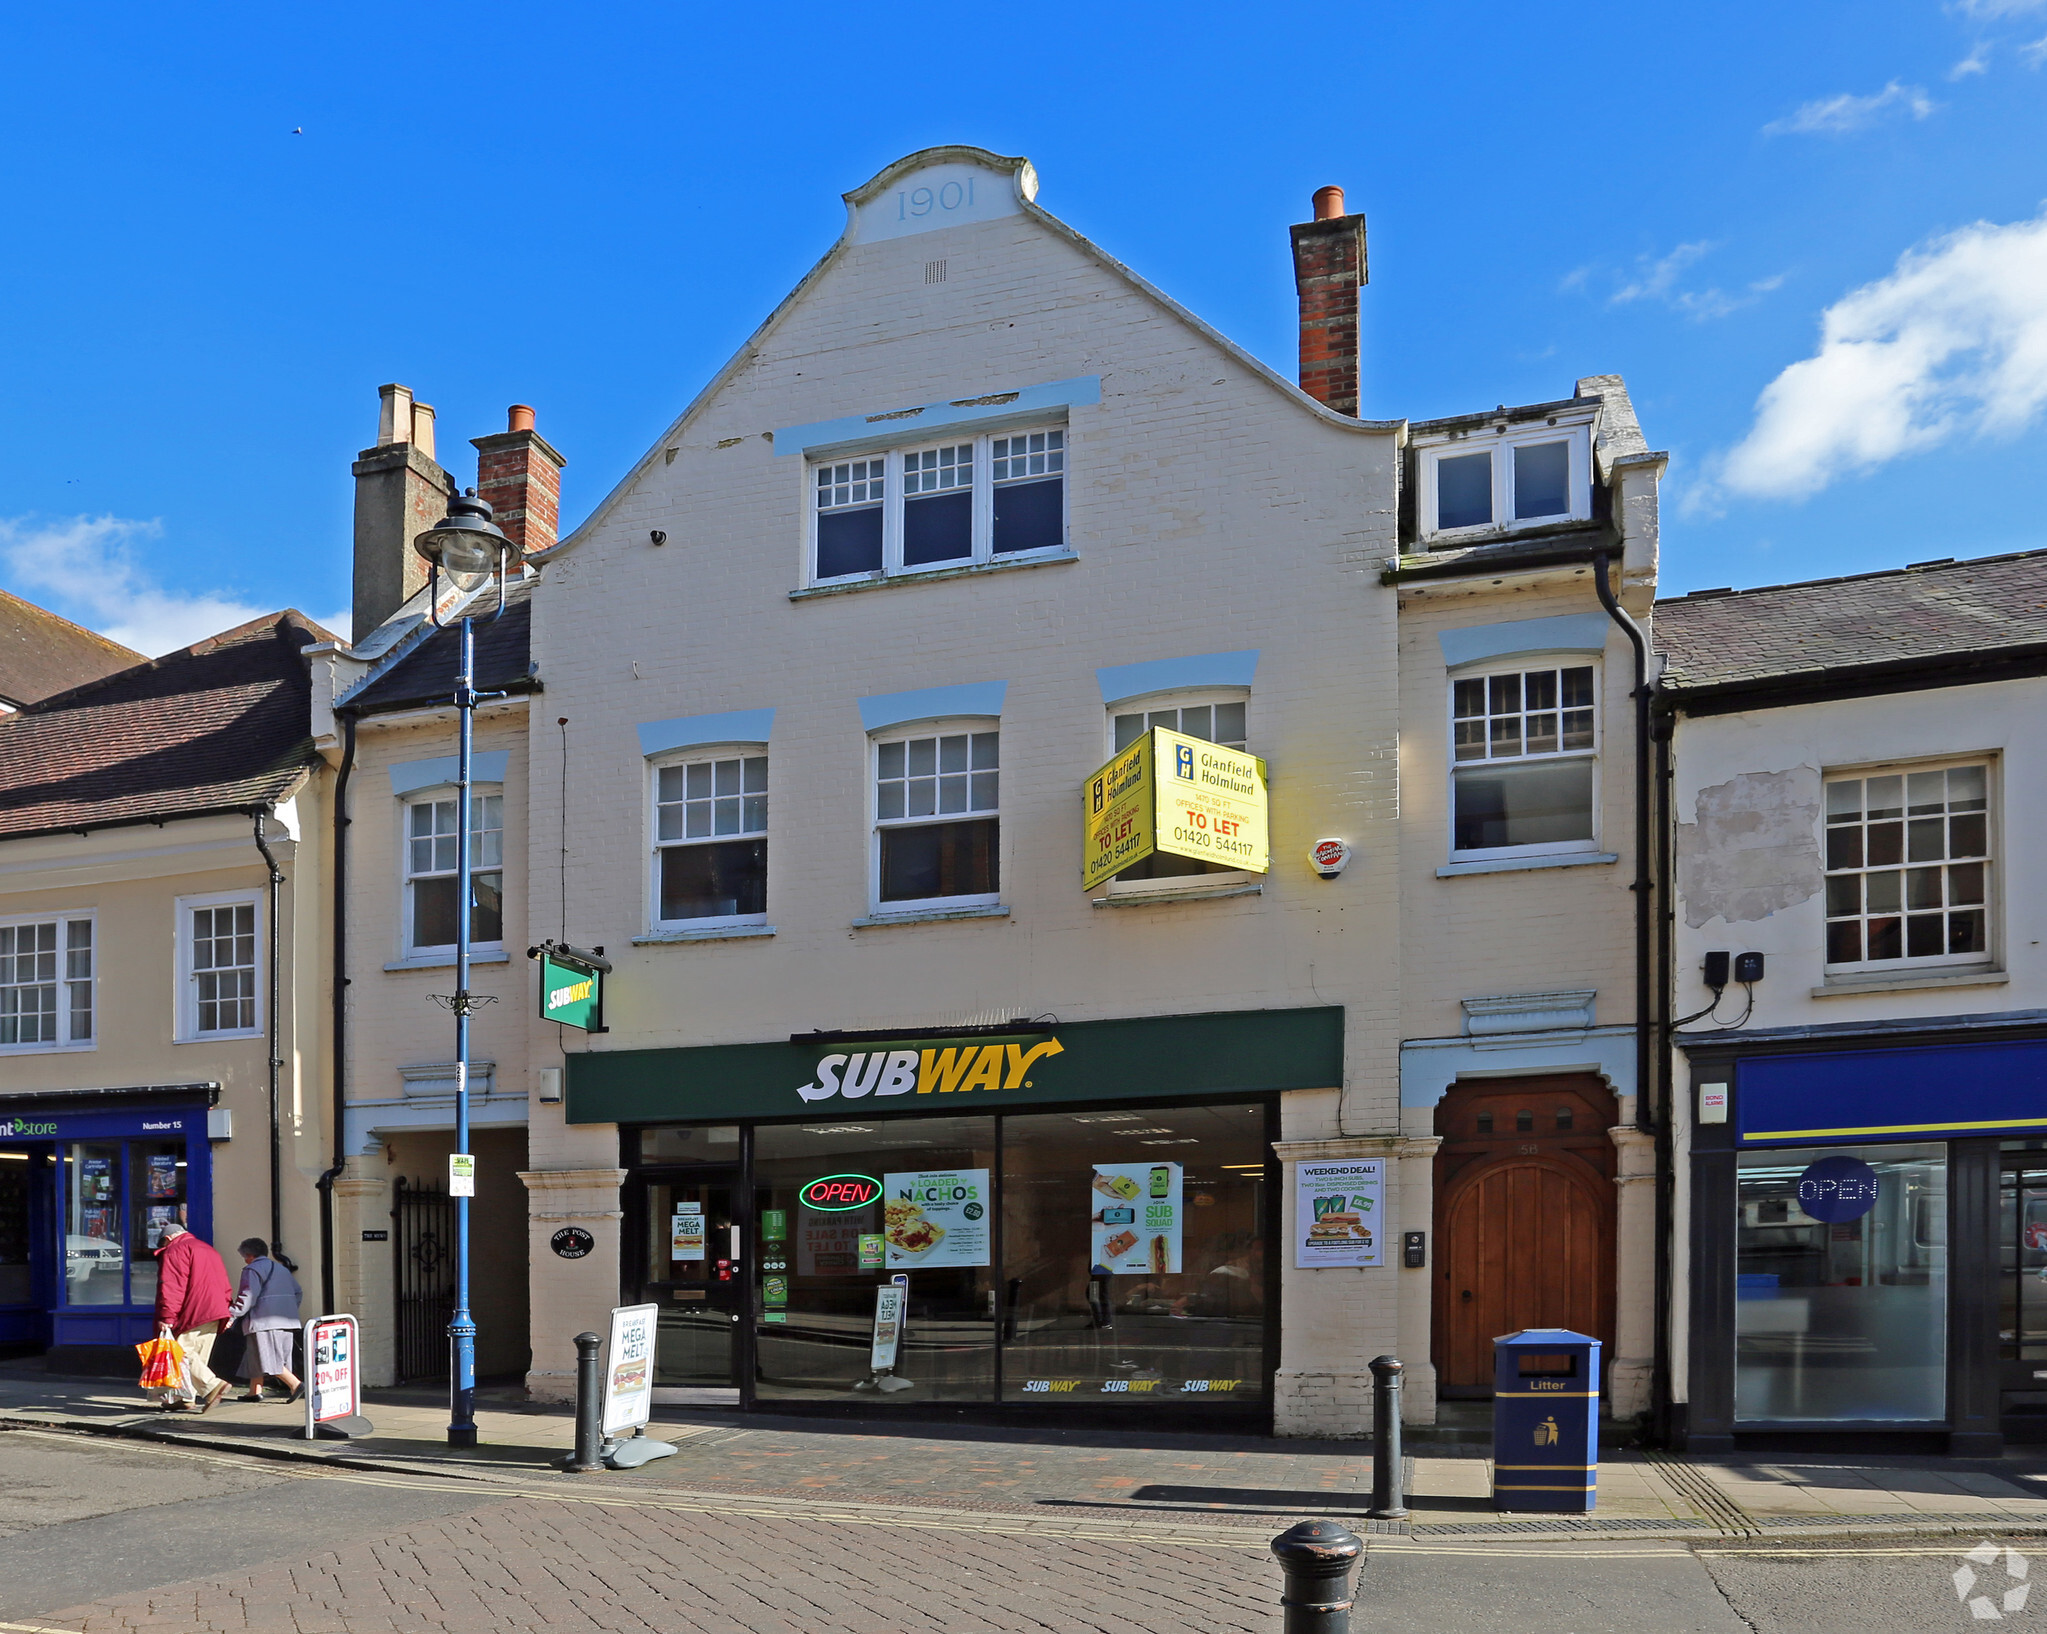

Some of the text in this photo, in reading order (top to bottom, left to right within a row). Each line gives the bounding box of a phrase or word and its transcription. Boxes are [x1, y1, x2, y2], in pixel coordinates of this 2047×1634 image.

[898, 177, 976, 221] 1901
[1180, 747, 1190, 762] G
[1107, 750, 1141, 786] Glanfield
[1180, 763, 1191, 779] H
[1201, 754, 1252, 779] Glanfield
[1107, 766, 1142, 802] Holmlund
[1202, 769, 1254, 795] Holmlund
[1114, 808, 1121, 818] SQ
[1121, 803, 1127, 813] FT
[1212, 798, 1221, 807] SQ
[1176, 799, 1249, 824] OFFICES WITH PARKING
[1094, 804, 1140, 841] OFFICES WITH PARKING
[1187, 811, 1239, 837] TO LET
[1099, 818, 1134, 852] TO LET
[1174, 827, 1253, 856] 01420 544117
[1090, 832, 1141, 874] 01420 544117
[548, 979, 594, 1010] SUBWAY
[796, 1036, 1065, 1104] SUBWAY
[23, 1122, 57, 1136] store
[143, 1121, 182, 1130] Number 15
[1304, 1166, 1376, 1176] WEEKEND DEAL!
[918, 1178, 959, 1187] LOADED
[1800, 1178, 1877, 1200] OPEN
[810, 1182, 872, 1202] OPEN
[900, 1186, 978, 1202] NACHOS
[1145, 1205, 1173, 1218] SUB
[678, 1227, 699, 1235] MELT
[1145, 1218, 1173, 1227] SQUAD
[553, 1229, 590, 1241] THE POST
[559, 1249, 585, 1257] HOUSE
[622, 1327, 646, 1345] MEGA
[622, 1342, 645, 1360] MELT
[315, 1367, 348, 1386] 20% OFF
[1022, 1379, 1081, 1392] SUBWAY
[1100, 1379, 1161, 1392] SUBWAY
[1180, 1379, 1242, 1392] SUBWAY
[1530, 1381, 1567, 1390] Litter
